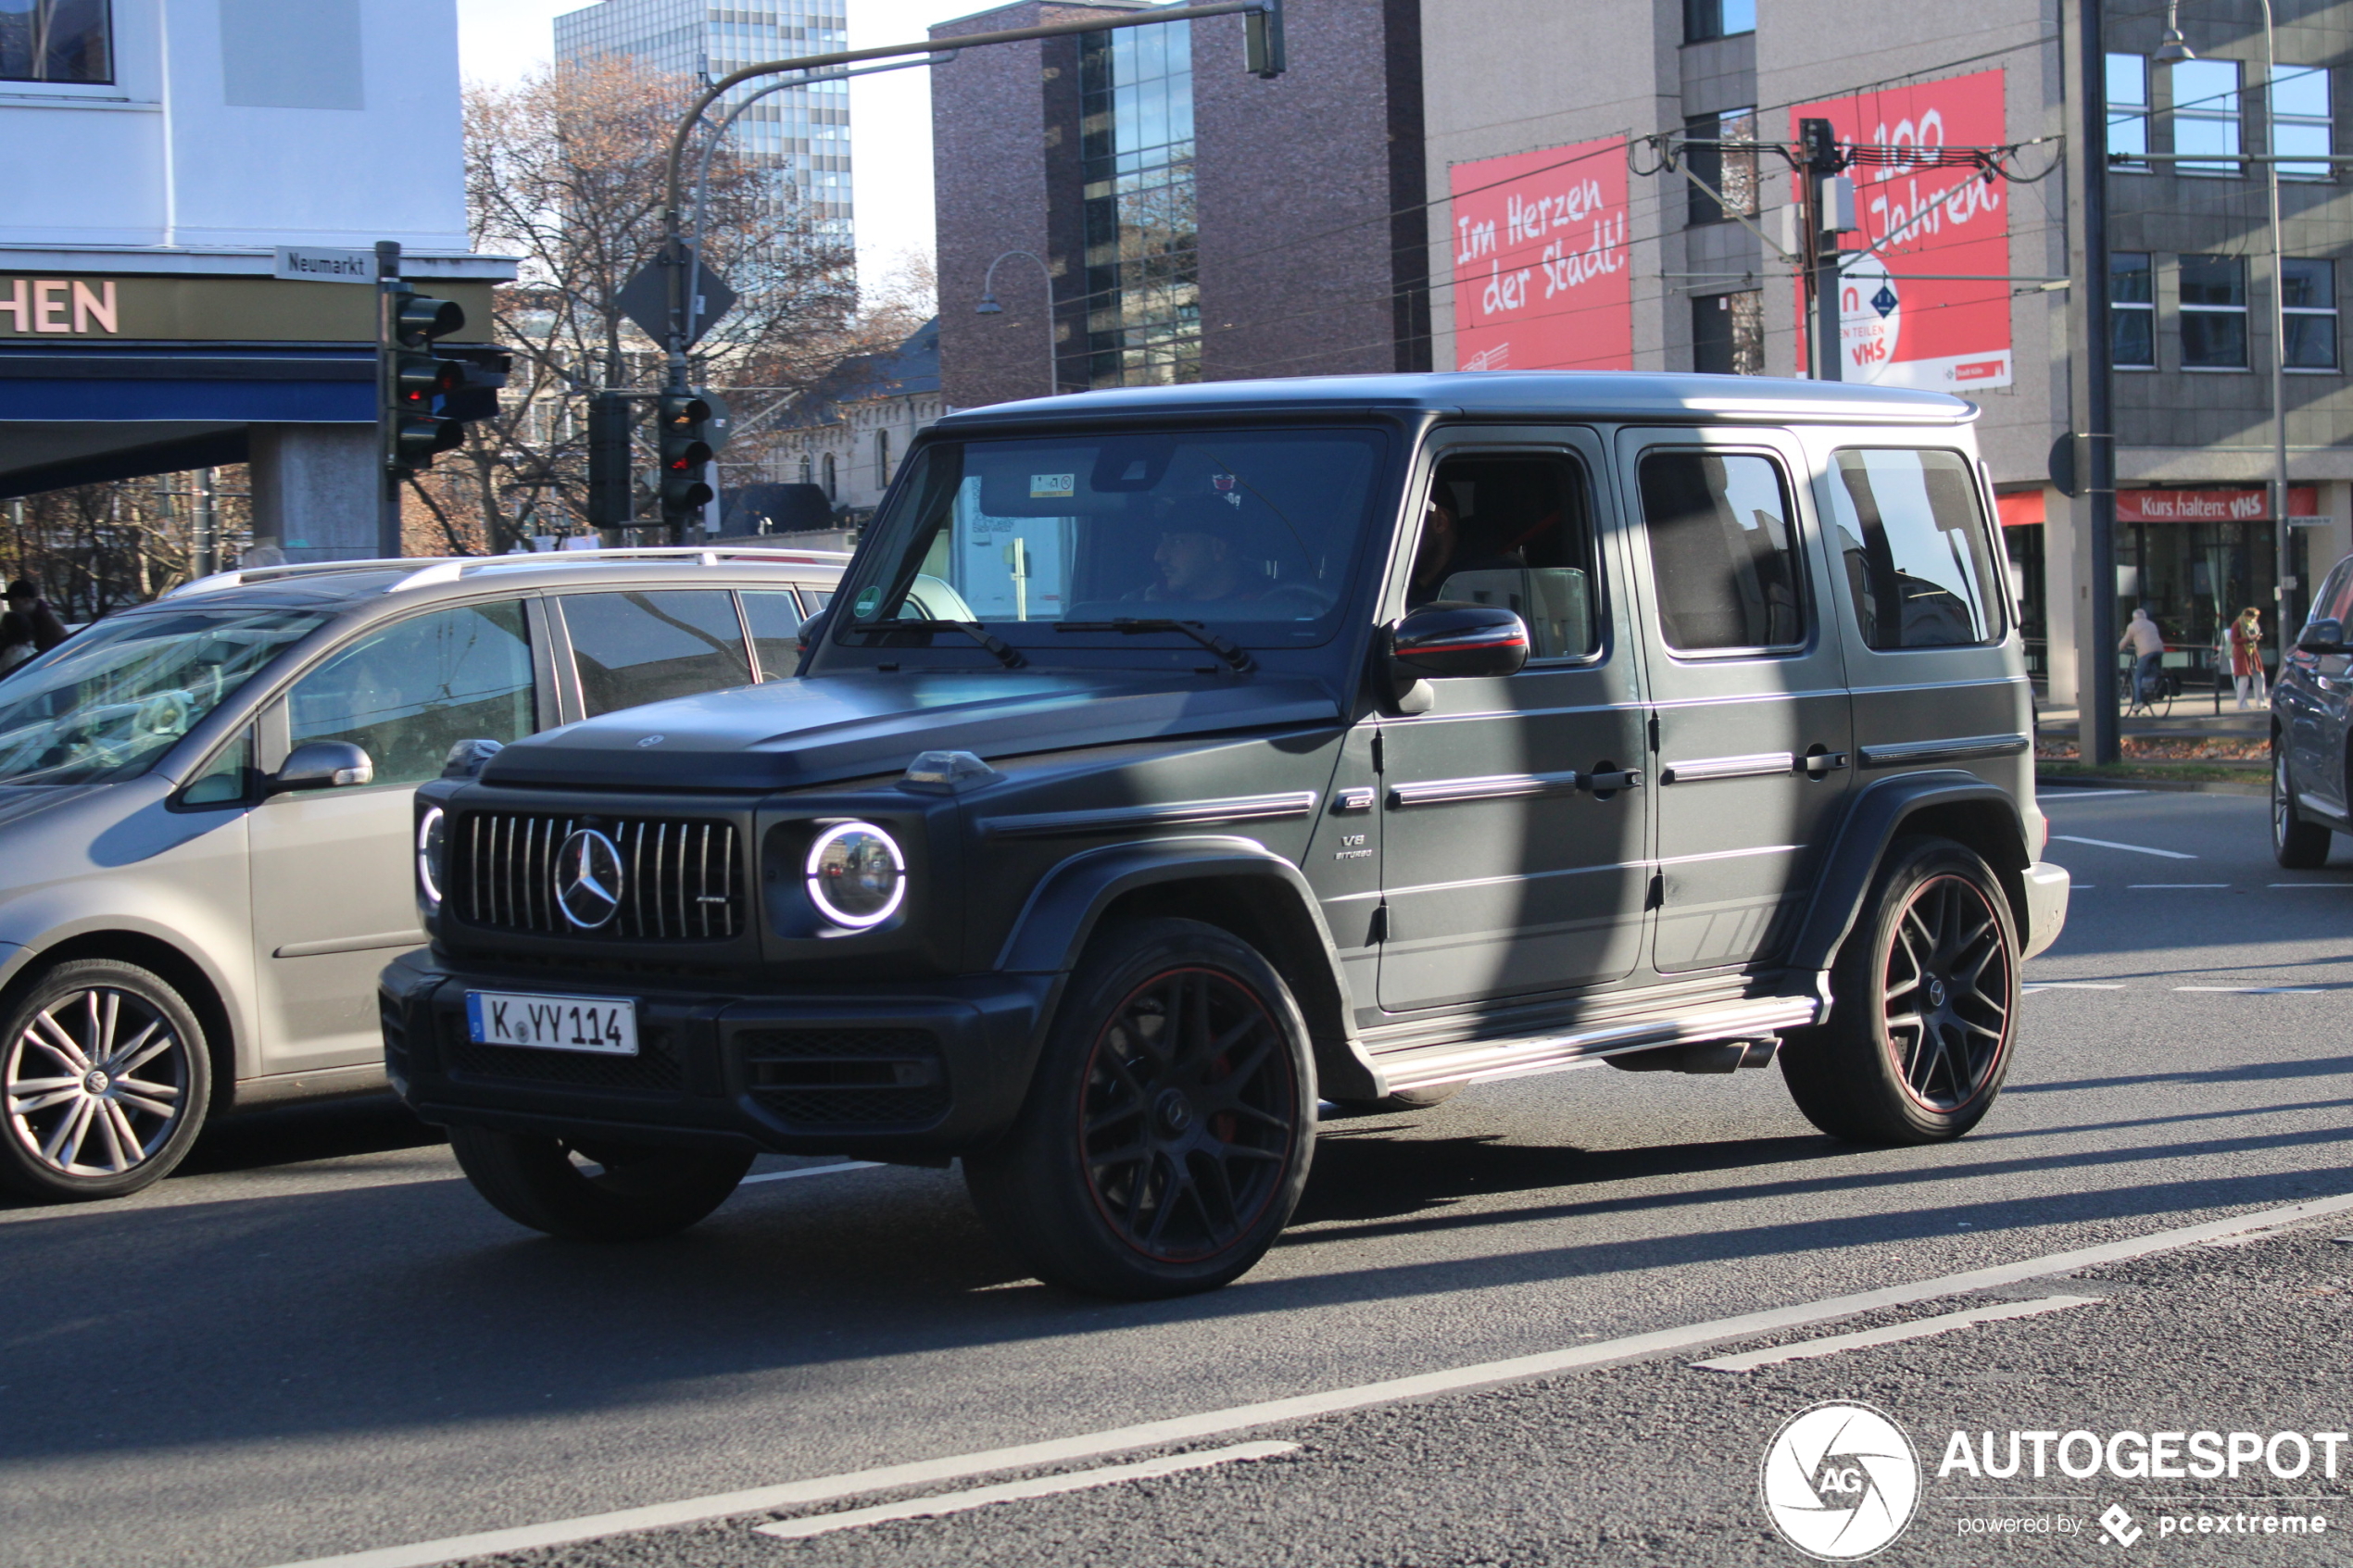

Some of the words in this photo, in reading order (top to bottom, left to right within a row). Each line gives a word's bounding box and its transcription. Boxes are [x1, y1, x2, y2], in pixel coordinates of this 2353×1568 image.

[1874, 107, 1944, 182] 100
[1457, 216, 1496, 265] Im
[1507, 178, 1603, 245] Herzen
[288, 252, 366, 276] Neumarkt
[1483, 258, 1530, 315] der
[1542, 211, 1624, 299] Stadt!
[1853, 325, 1884, 337] TEILEN
[1852, 337, 1886, 366] VHS
[2142, 496, 2173, 517] Kurs
[2176, 495, 2225, 517] halten:
[2230, 493, 2261, 520] VHS
[1335, 849, 1373, 859] BITURBO
[1342, 834, 1365, 847] V8
[492, 1000, 511, 1038] K
